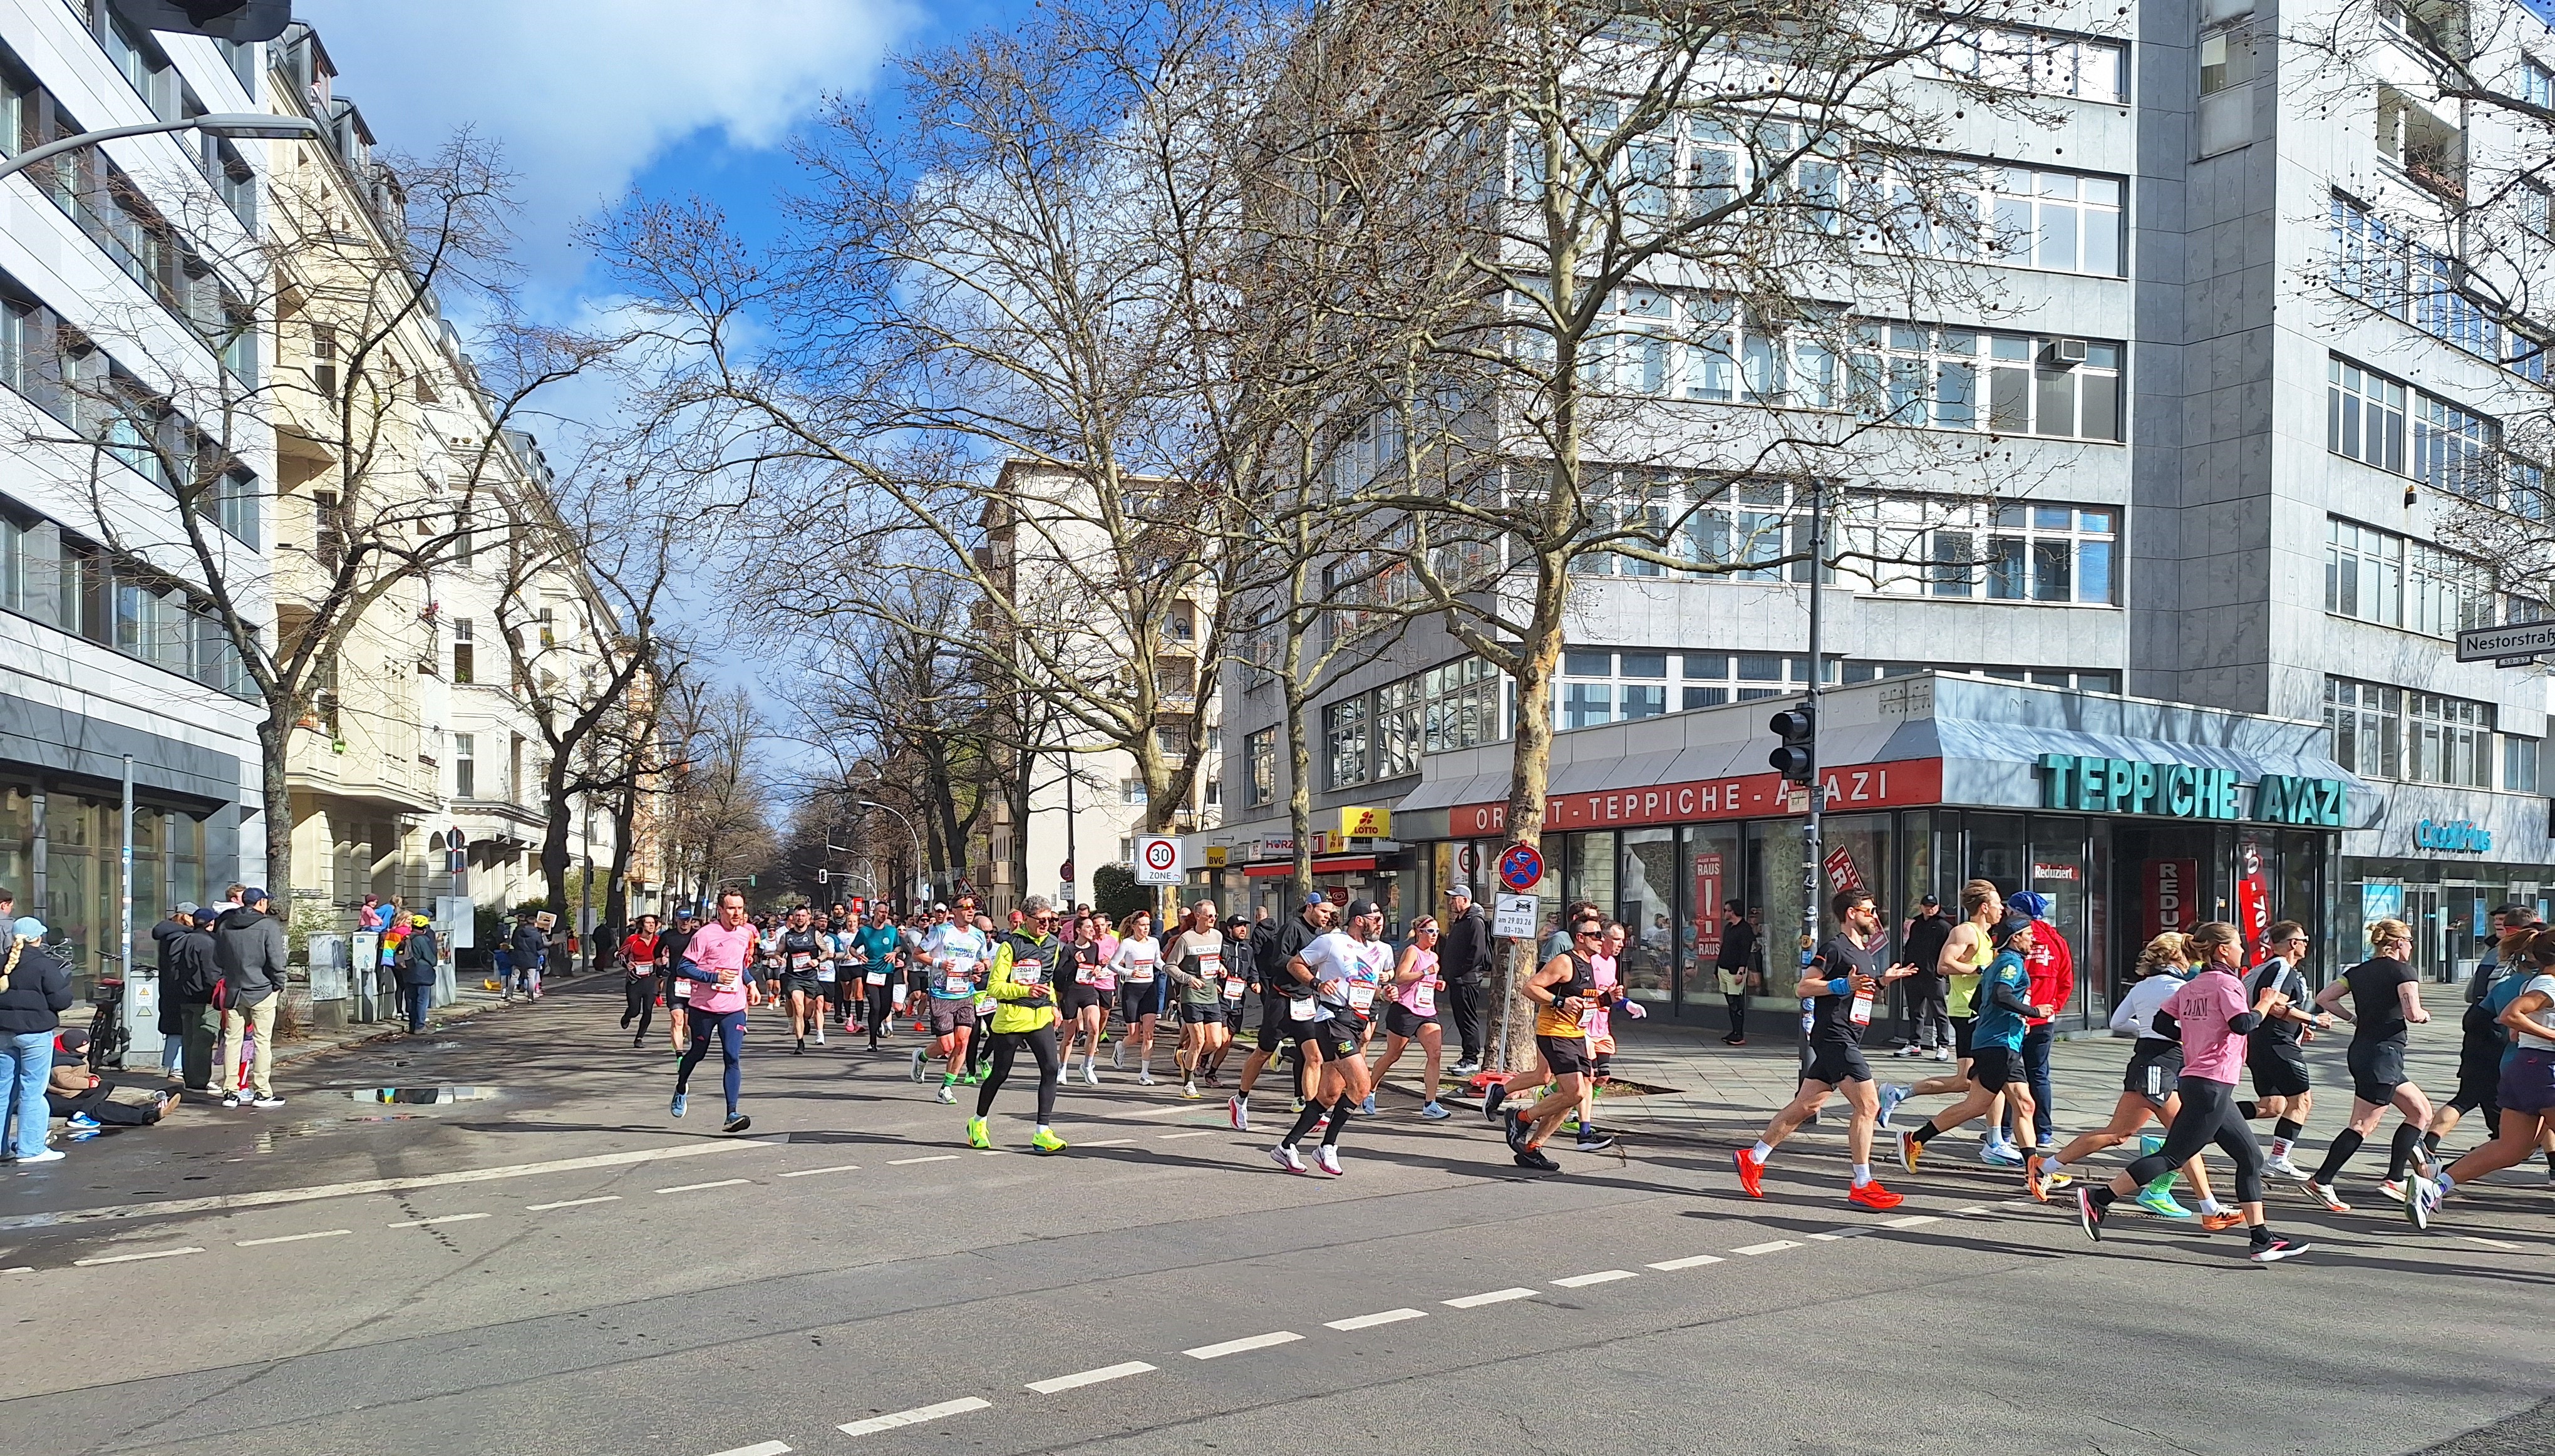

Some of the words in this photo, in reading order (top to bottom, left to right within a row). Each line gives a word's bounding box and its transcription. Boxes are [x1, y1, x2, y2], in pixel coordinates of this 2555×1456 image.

[2040, 753, 2240, 820] TEPPICHE
[2256, 774, 2347, 827] AYAZI
[1354, 826, 1378, 834] LOTTO
[1152, 849, 1169, 862] 30
[1209, 856, 1224, 865] BVG
[1697, 863, 1720, 875] RAUS
[2035, 865, 2073, 879] Reduziert
[1149, 872, 1172, 880] ZONE
[1842, 861, 1859, 889] ALLE
[2159, 863, 2179, 932] REDU
[1507, 917, 1532, 926] 29.03.26
[1504, 926, 1524, 934] 03-13h
[1698, 944, 1720, 955] RAUS
